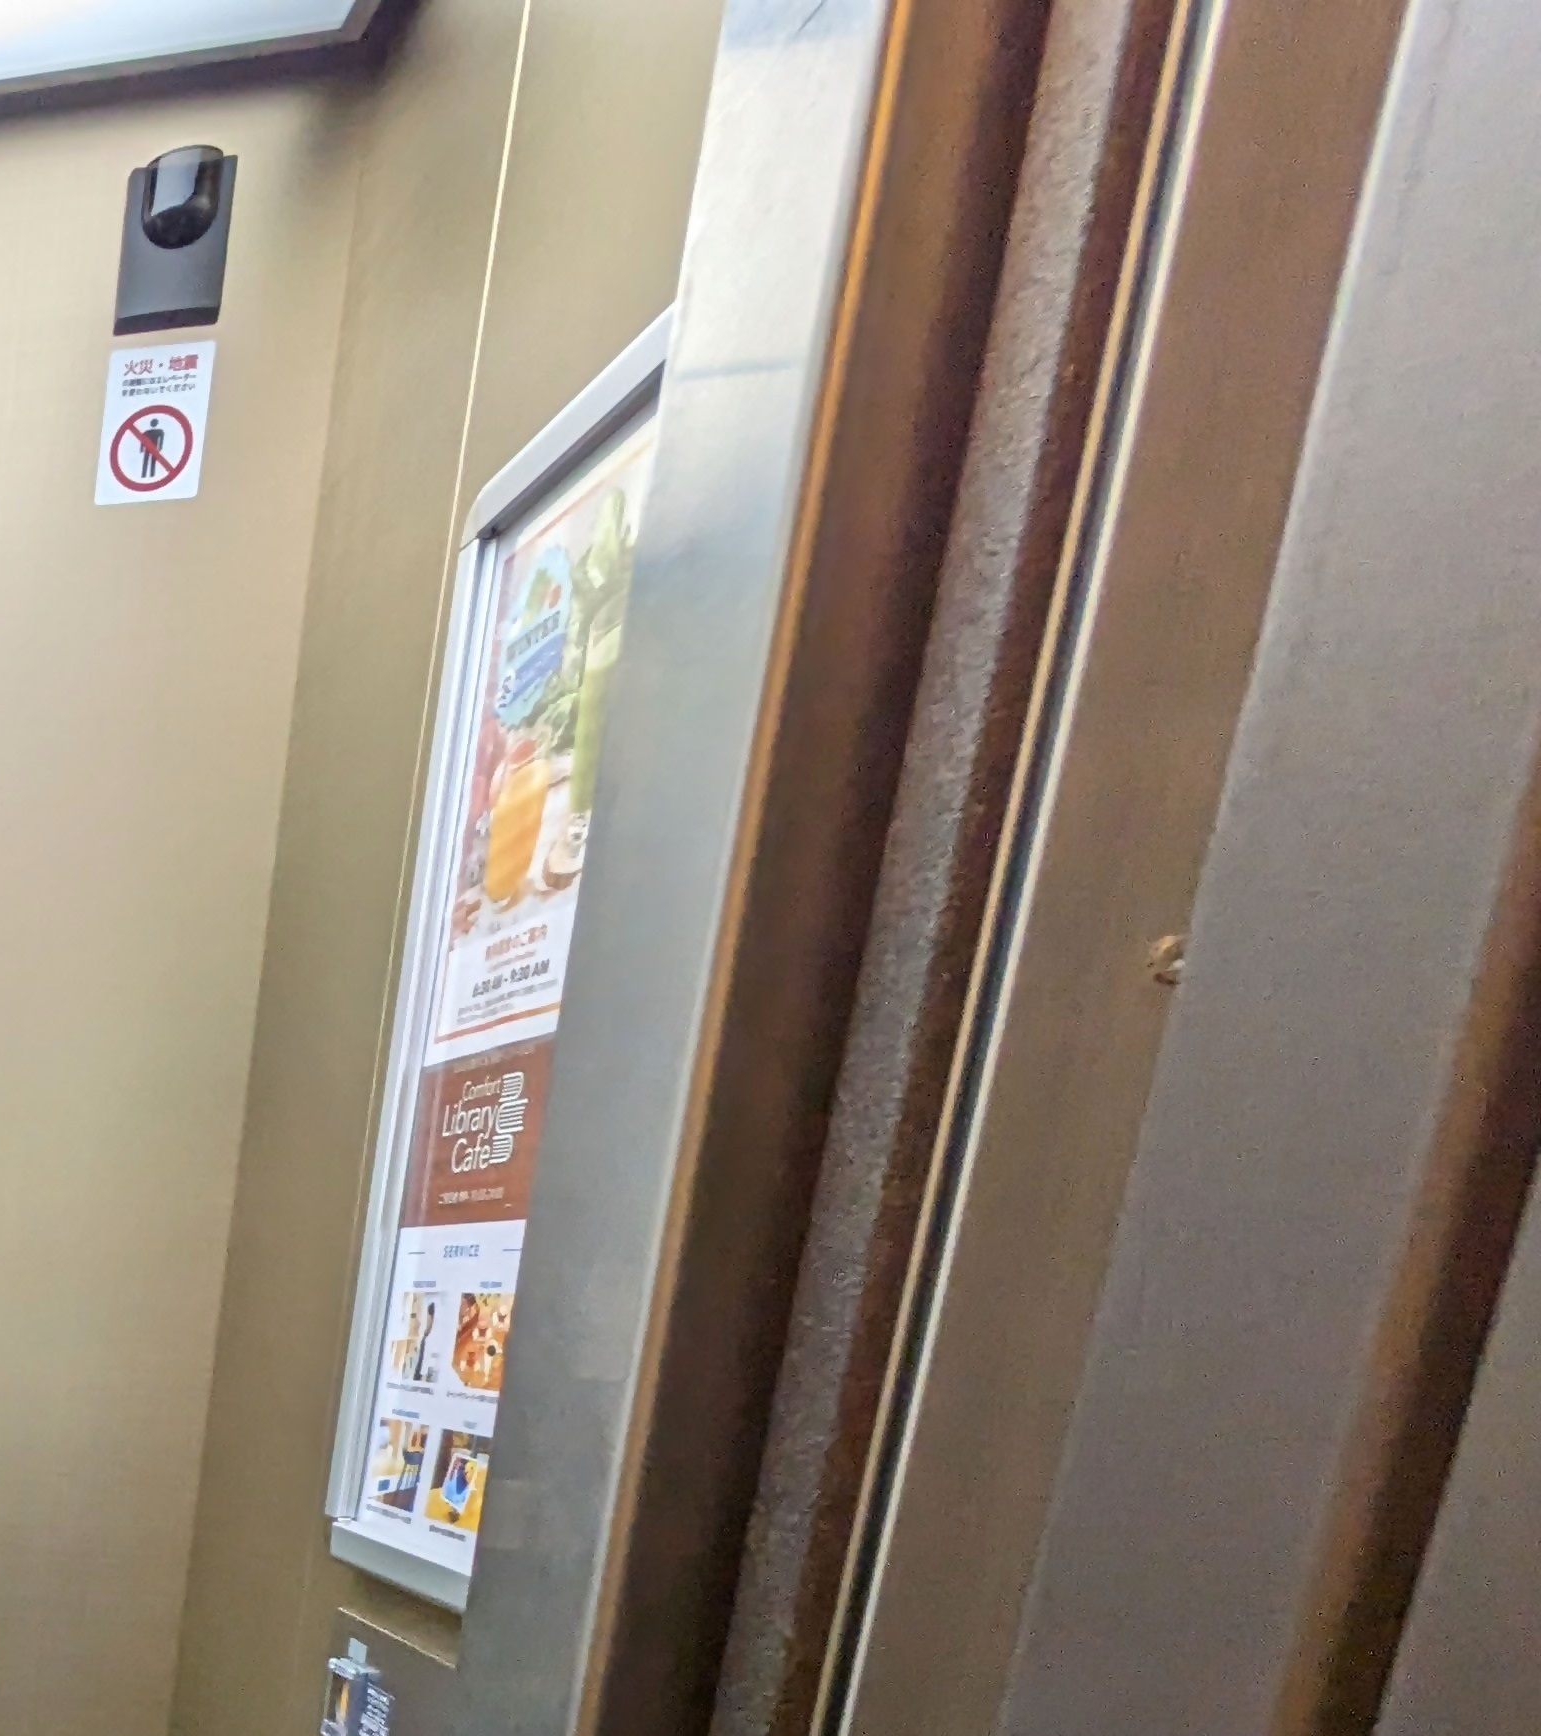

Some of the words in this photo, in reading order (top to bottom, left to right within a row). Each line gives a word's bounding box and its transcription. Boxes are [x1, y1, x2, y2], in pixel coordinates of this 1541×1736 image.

[462, 1075, 502, 1101] Comfort
[442, 1099, 499, 1140] Library
[451, 1132, 491, 1174] Cafe
[443, 1244, 480, 1258] SERVICE
